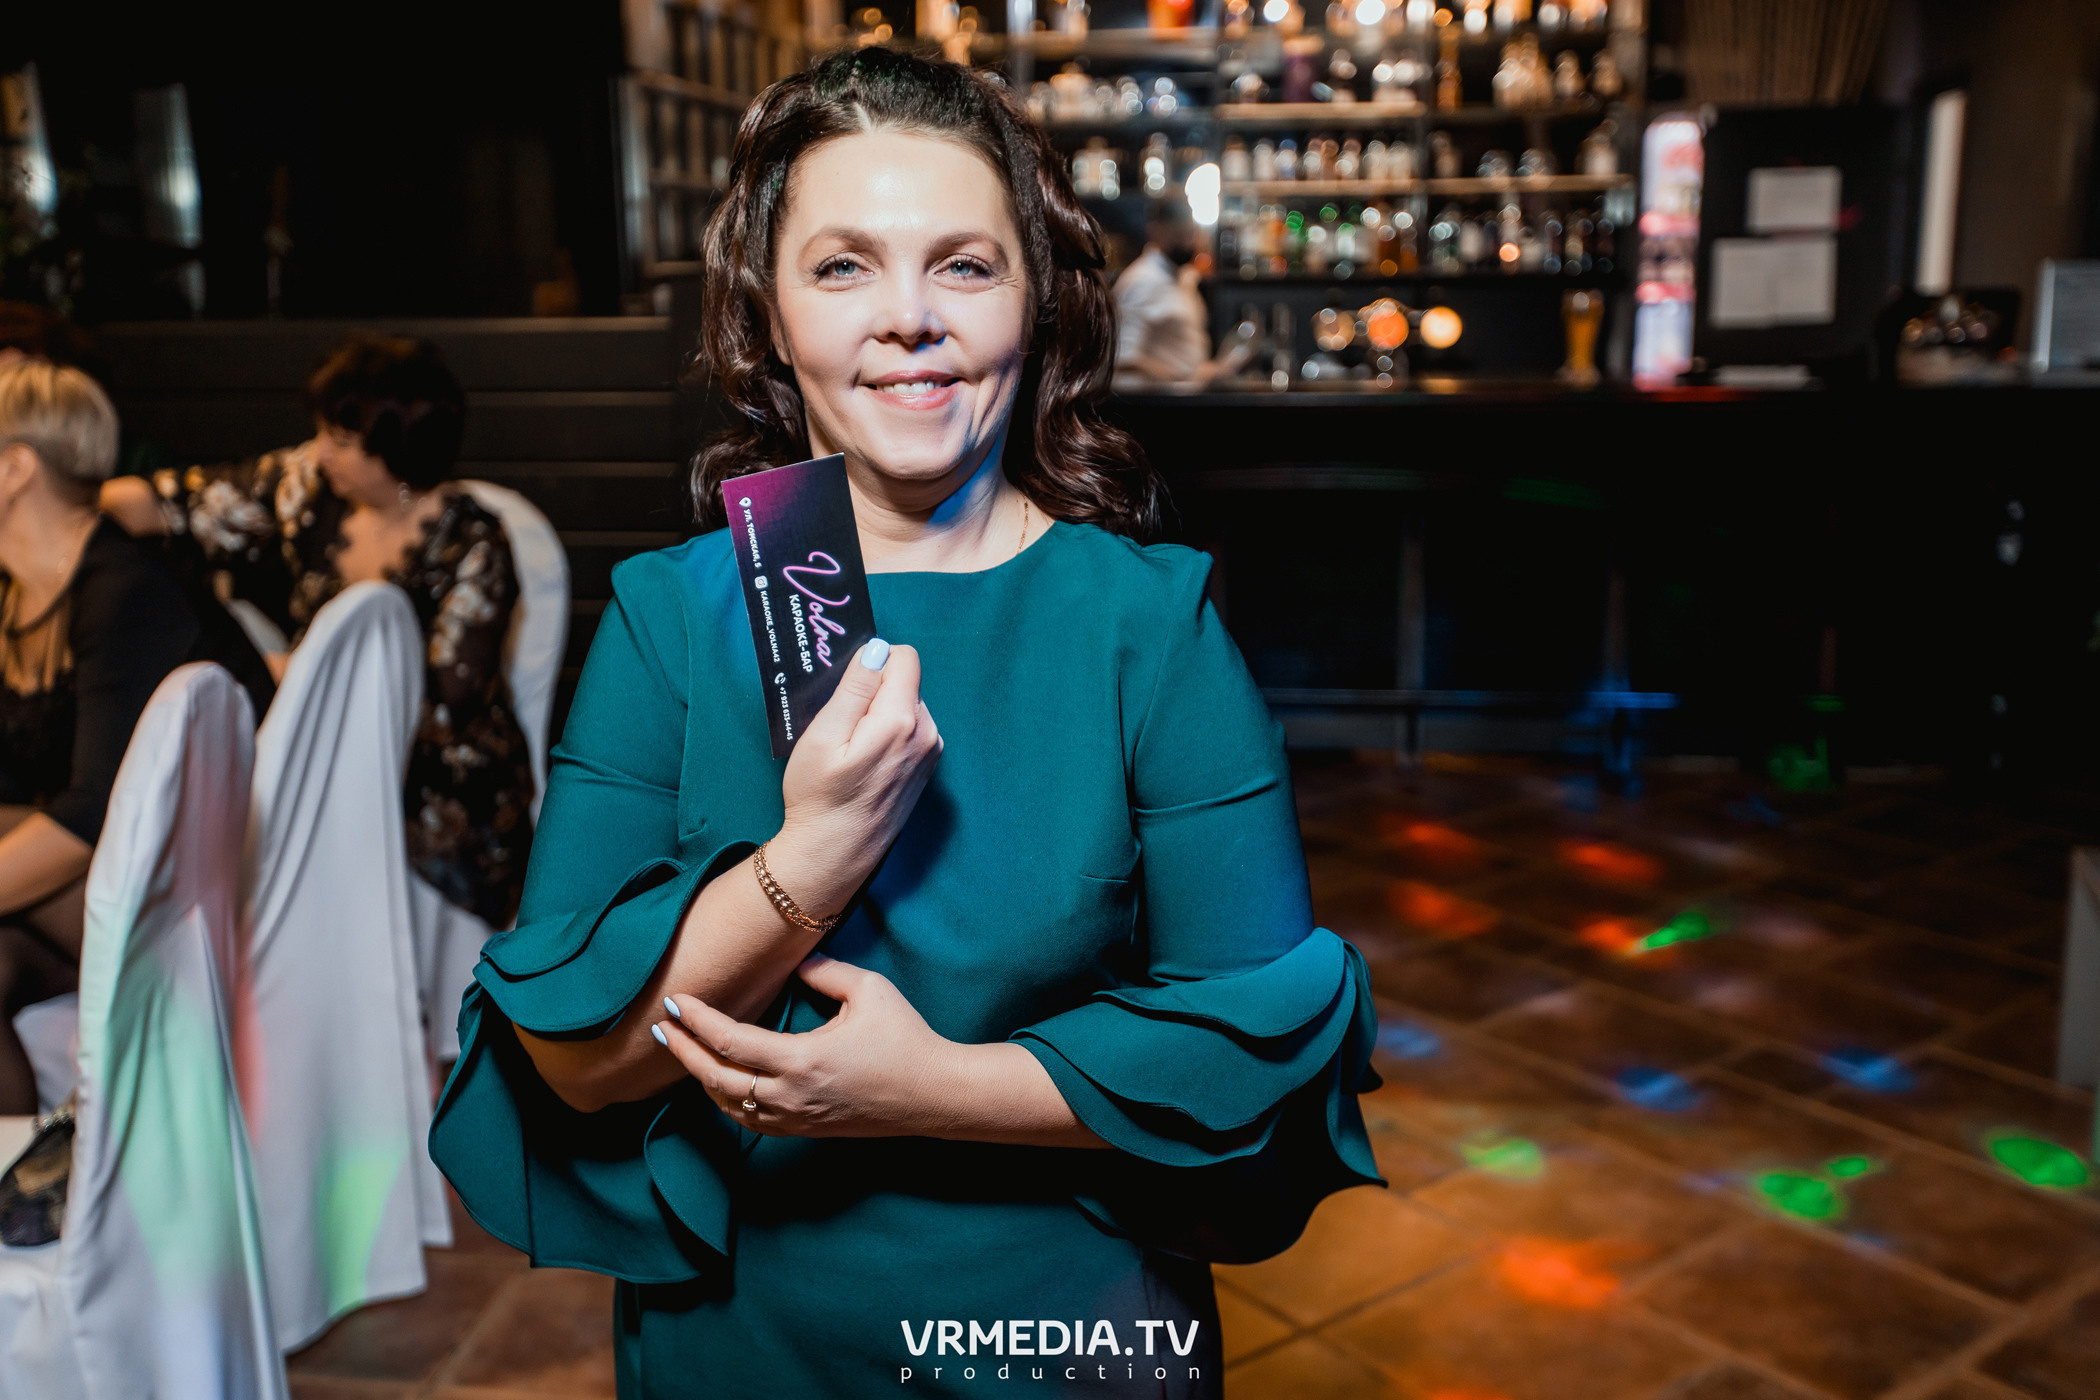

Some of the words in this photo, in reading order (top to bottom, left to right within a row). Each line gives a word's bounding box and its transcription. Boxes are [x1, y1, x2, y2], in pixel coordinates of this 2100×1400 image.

[743, 508, 753, 523] УЛ.
[760, 590, 781, 663] KARAOKE_VOLNA42
[782, 551, 850, 667] Volna
[789, 593, 814, 673] КАРАОКЕ-БАР
[779, 686, 787, 695] +7
[780, 695, 789, 708] 923
